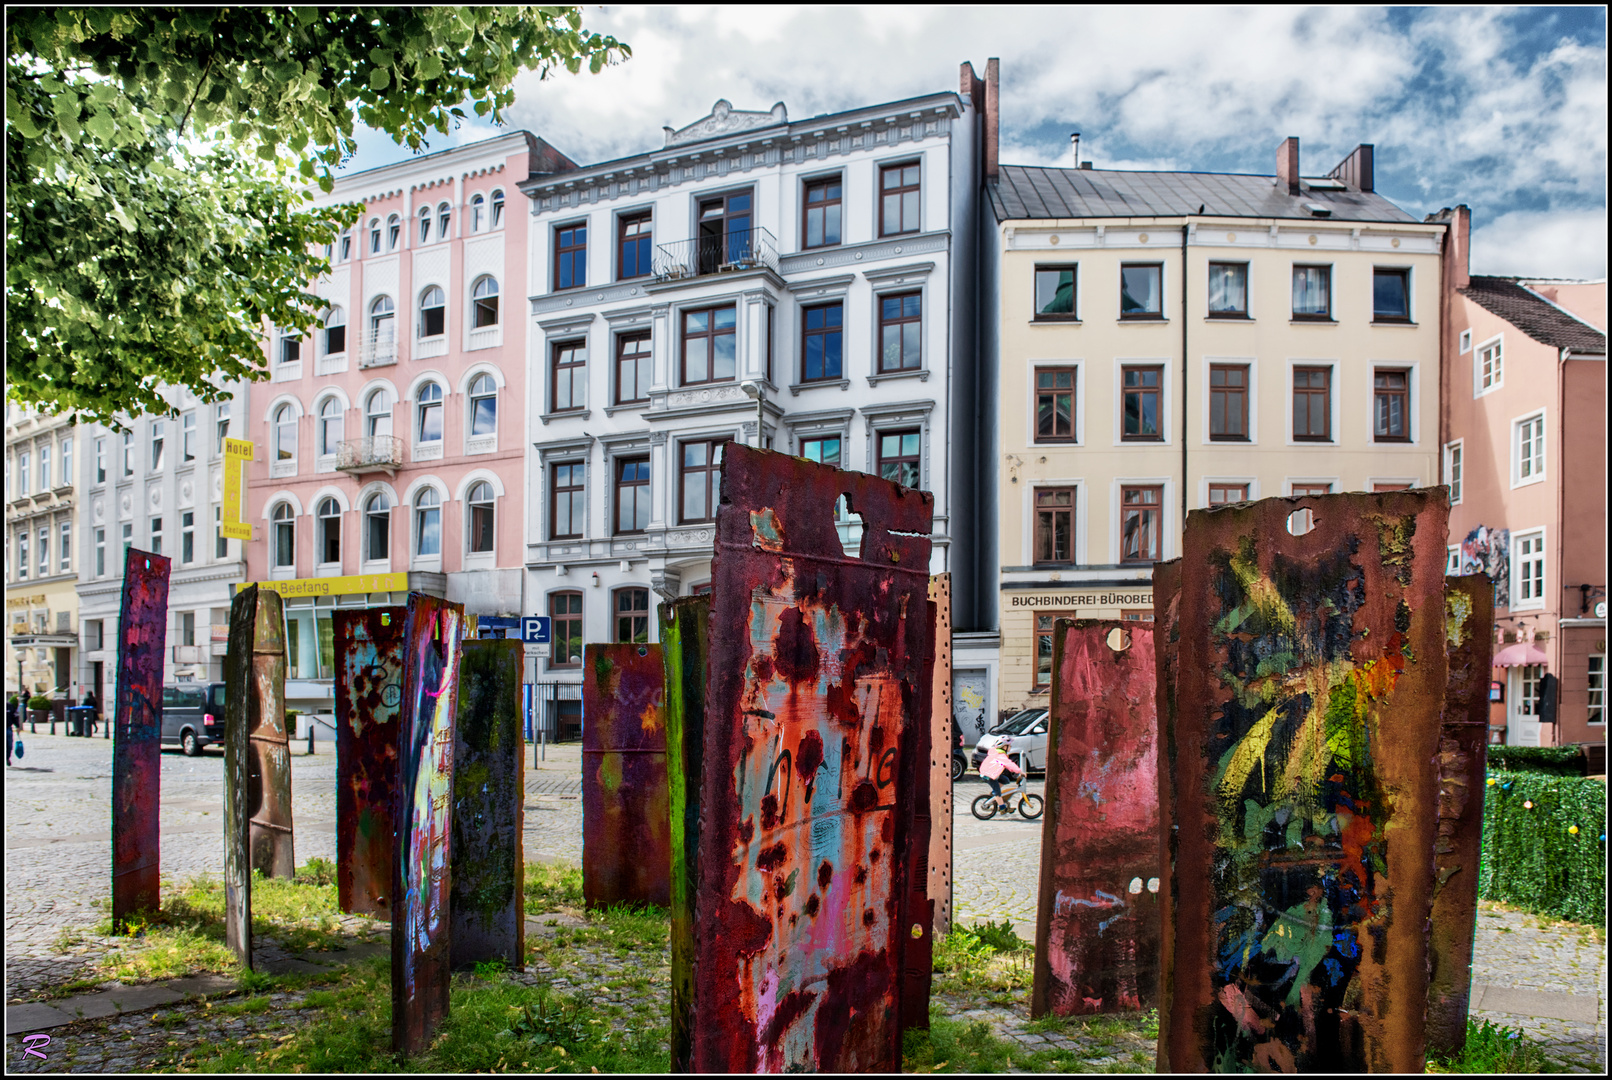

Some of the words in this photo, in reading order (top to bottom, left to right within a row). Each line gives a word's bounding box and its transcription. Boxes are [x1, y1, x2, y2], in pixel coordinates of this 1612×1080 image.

[227, 441, 251, 456] Hotel
[225, 525, 250, 537] Beefang
[281, 581, 329, 594] Beefang
[526, 620, 541, 640] P
